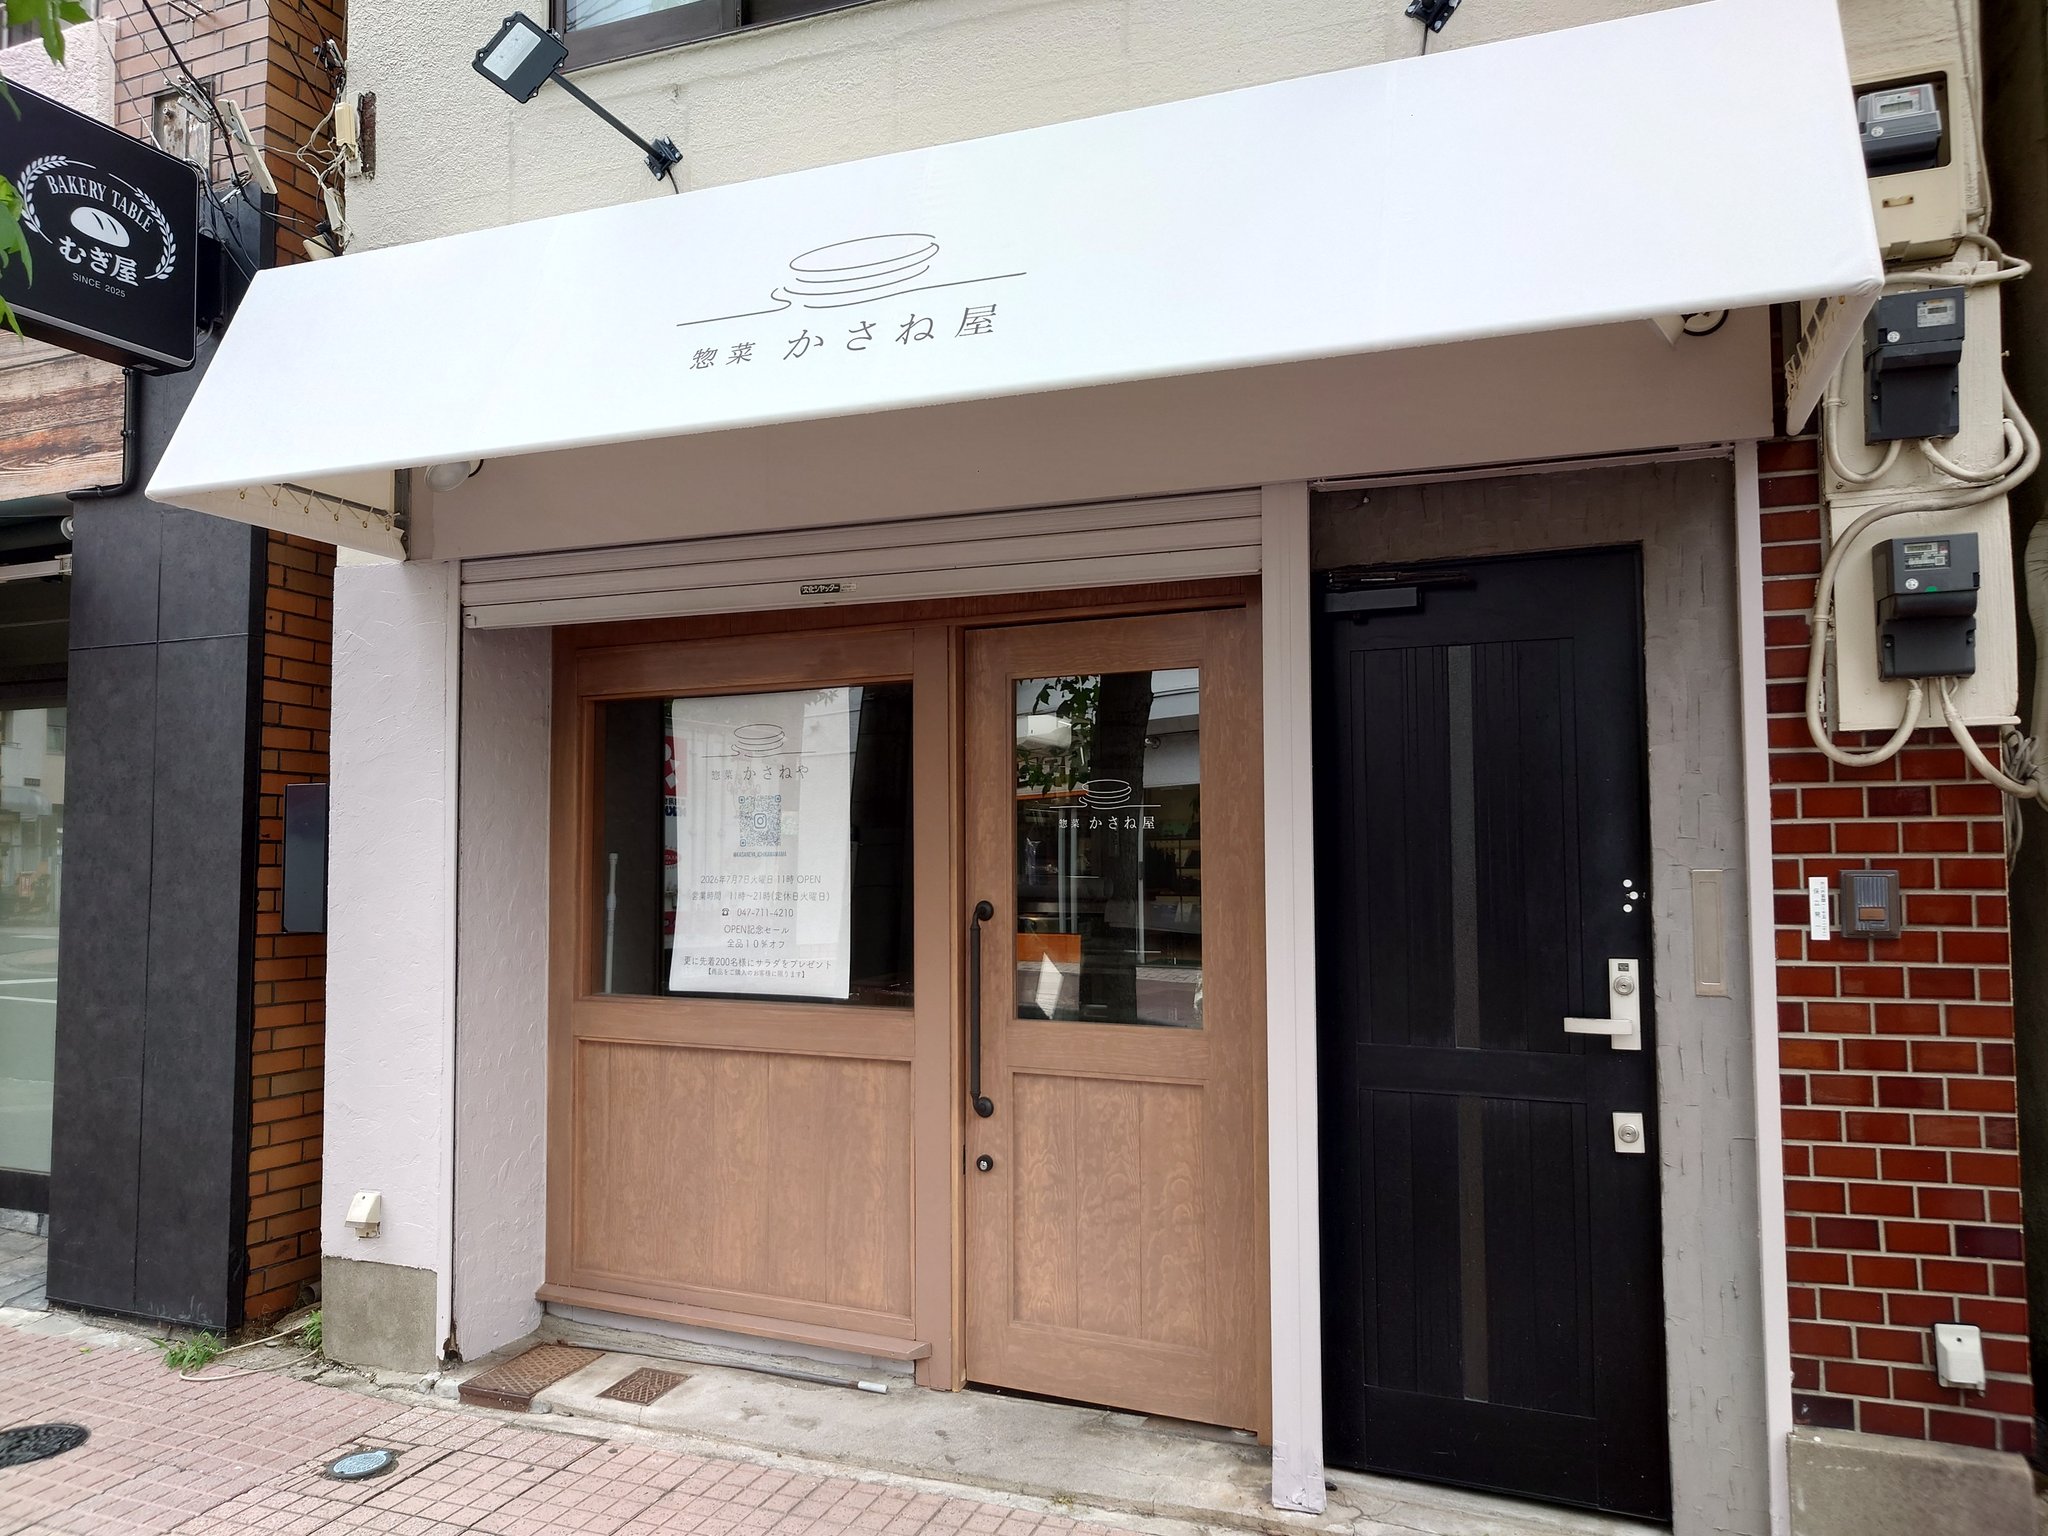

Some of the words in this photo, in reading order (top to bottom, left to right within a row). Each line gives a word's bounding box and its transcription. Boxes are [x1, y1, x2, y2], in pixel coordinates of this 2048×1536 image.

[45, 174, 107, 200] BAKERY
[111, 188, 155, 233] TABLE
[58, 235, 140, 287] むぎ屋
[72, 272, 102, 289] SINCE
[104, 284, 127, 298] 2025
[689, 341, 756, 371] 惣菜
[782, 302, 998, 361] かさね屋
[711, 769, 734, 782] 惣菜
[743, 764, 809, 781] かさねや
[1058, 818, 1080, 829] 惣菜
[1089, 815, 1155, 830] かさね屋
[796, 874, 821, 884] OPEN
[691, 890, 721, 901] 営業時間
[737, 907, 794, 918] 047-711-4210
[724, 924, 790, 935] OPEN記念セール
